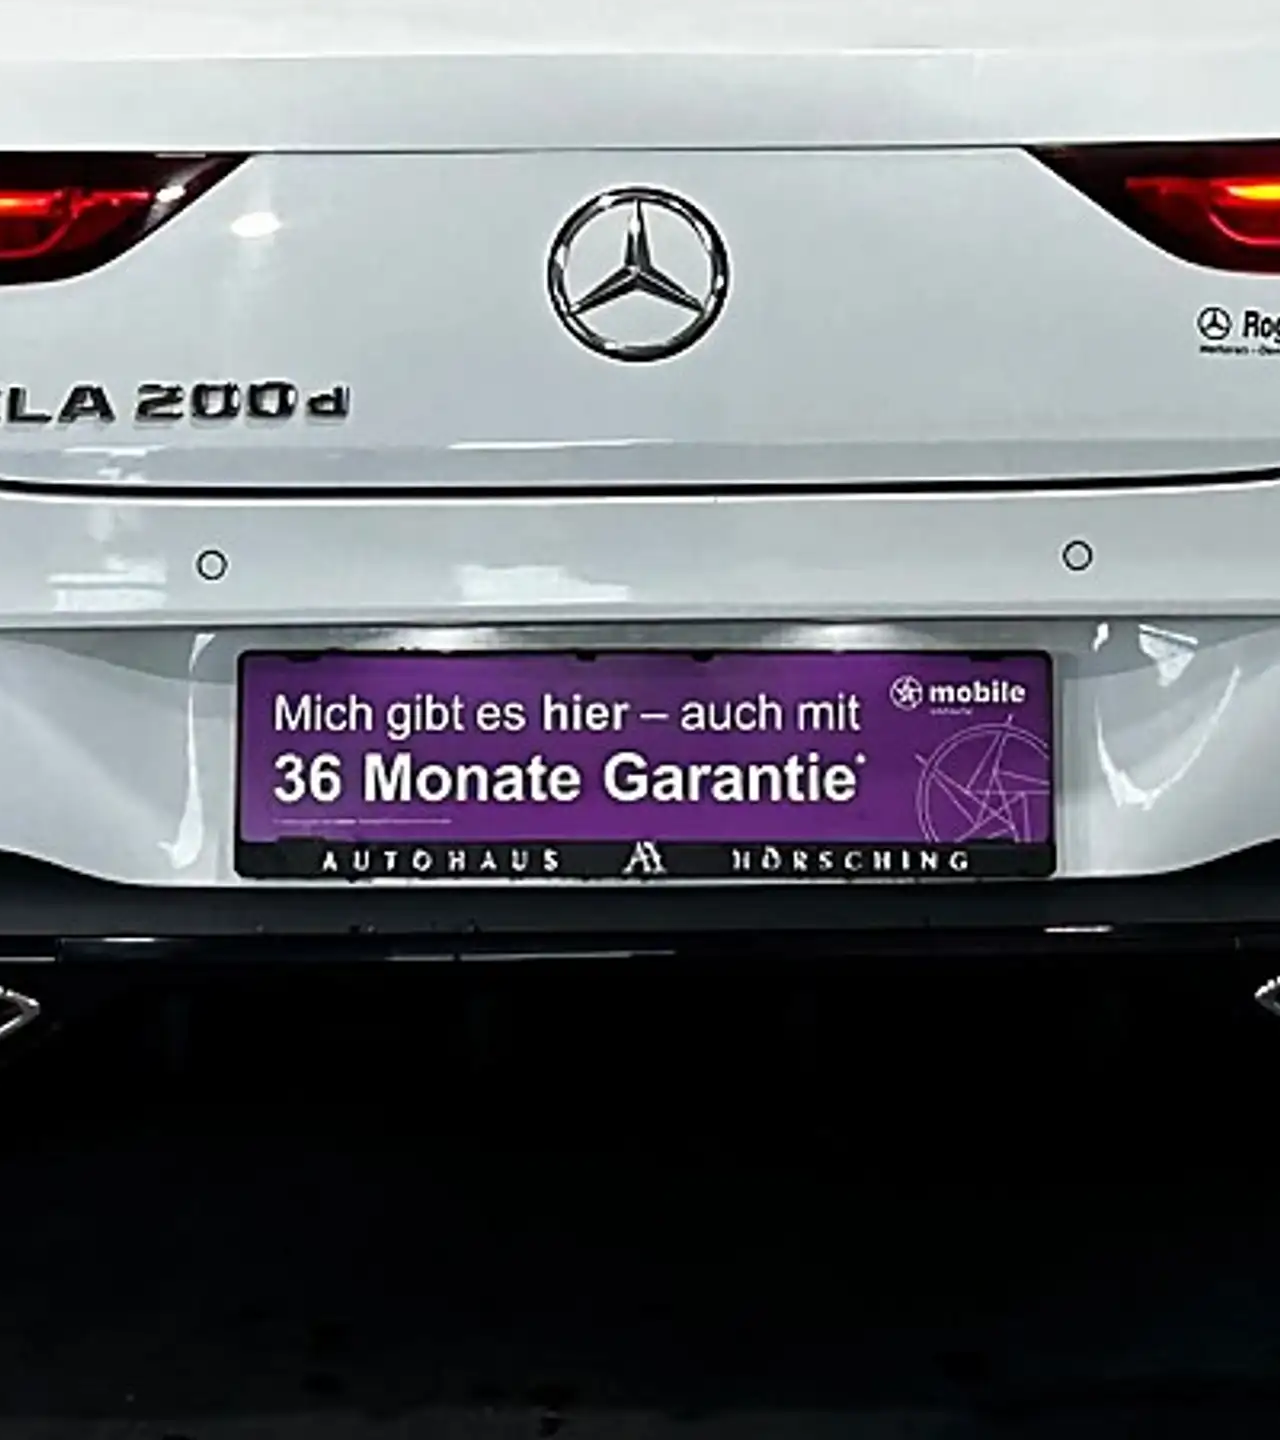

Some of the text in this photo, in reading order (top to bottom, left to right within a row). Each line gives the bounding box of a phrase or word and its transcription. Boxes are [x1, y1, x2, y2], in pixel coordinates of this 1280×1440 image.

[929, 679, 1027, 703] mobile
[274, 693, 373, 731] Mich
[386, 693, 465, 741] gibt
[476, 702, 526, 731] es
[544, 693, 630, 731] hier
[680, 693, 782, 731] auch
[797, 693, 861, 731] mit
[273, 752, 342, 802] 36
[364, 752, 581, 802] Monate
[322, 848, 559, 872] AUTOHAUS
